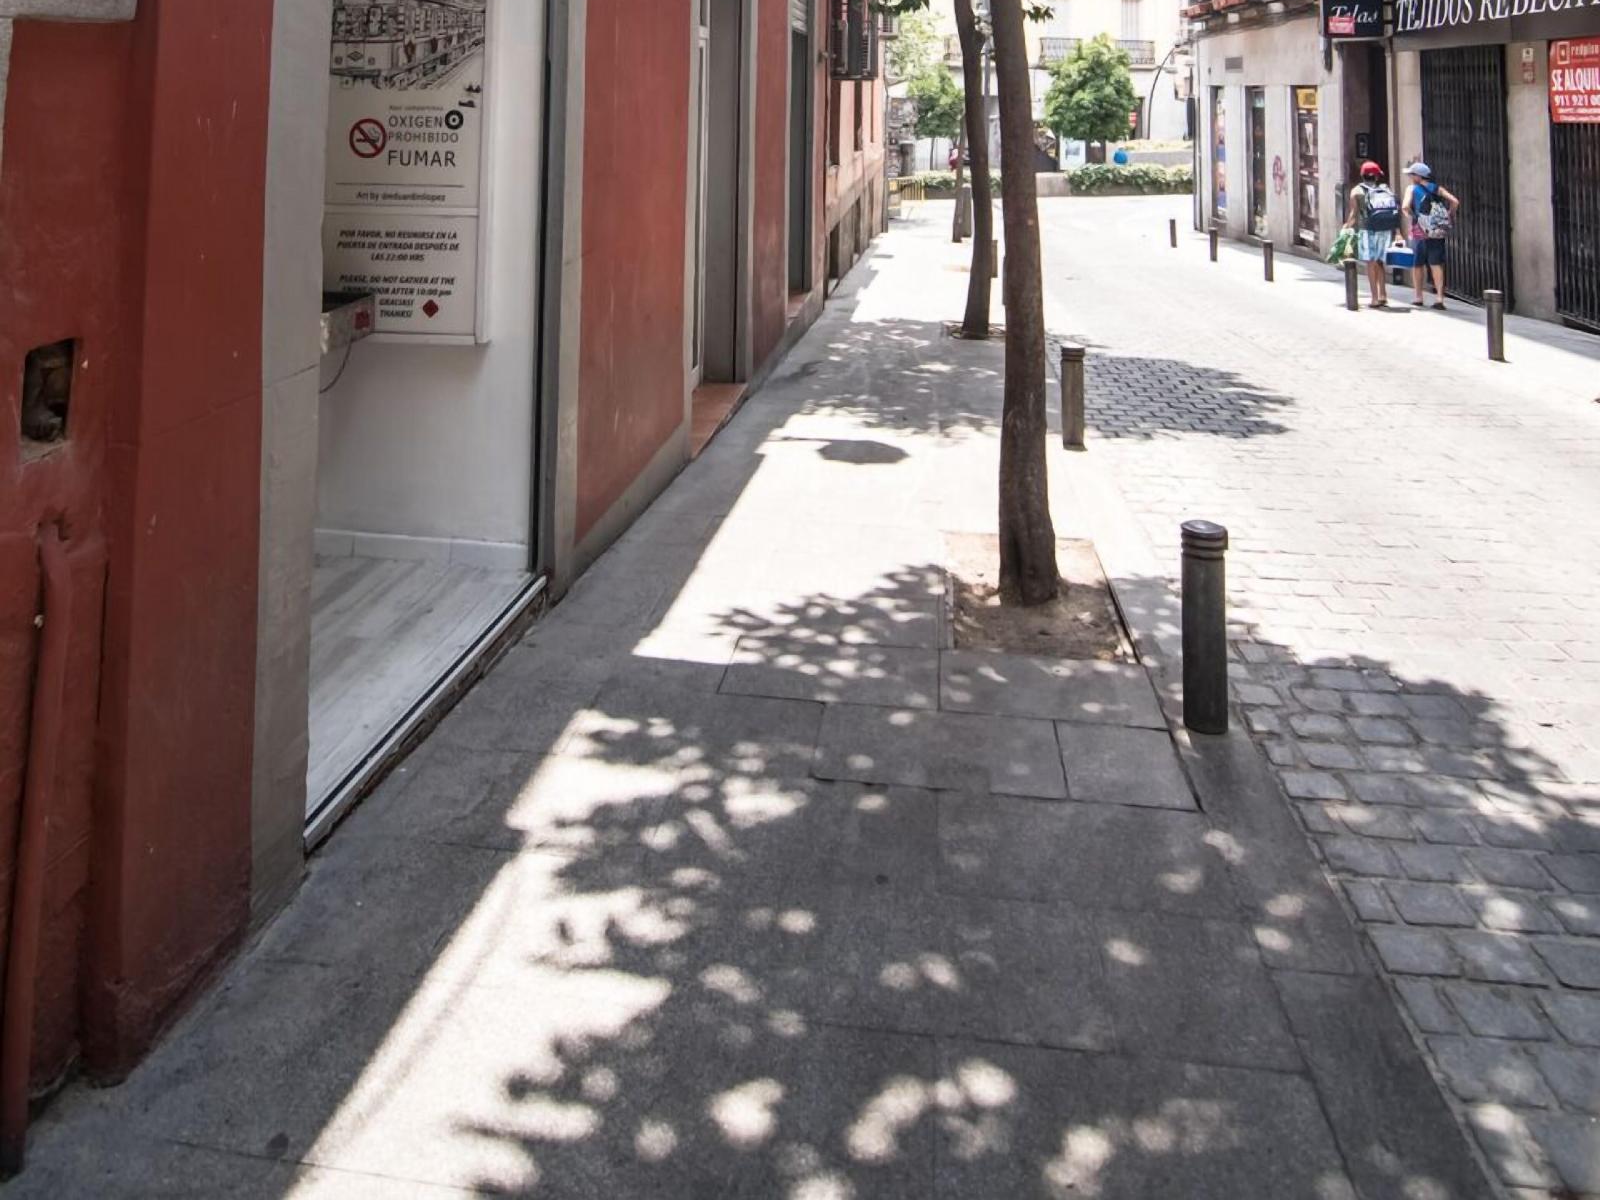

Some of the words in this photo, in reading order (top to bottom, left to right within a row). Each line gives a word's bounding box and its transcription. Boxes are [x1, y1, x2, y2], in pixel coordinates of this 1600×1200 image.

[1552, 69, 1563, 91] SE
[388, 131, 459, 143] PROHIBIDO
[387, 149, 456, 167] FUMAR
